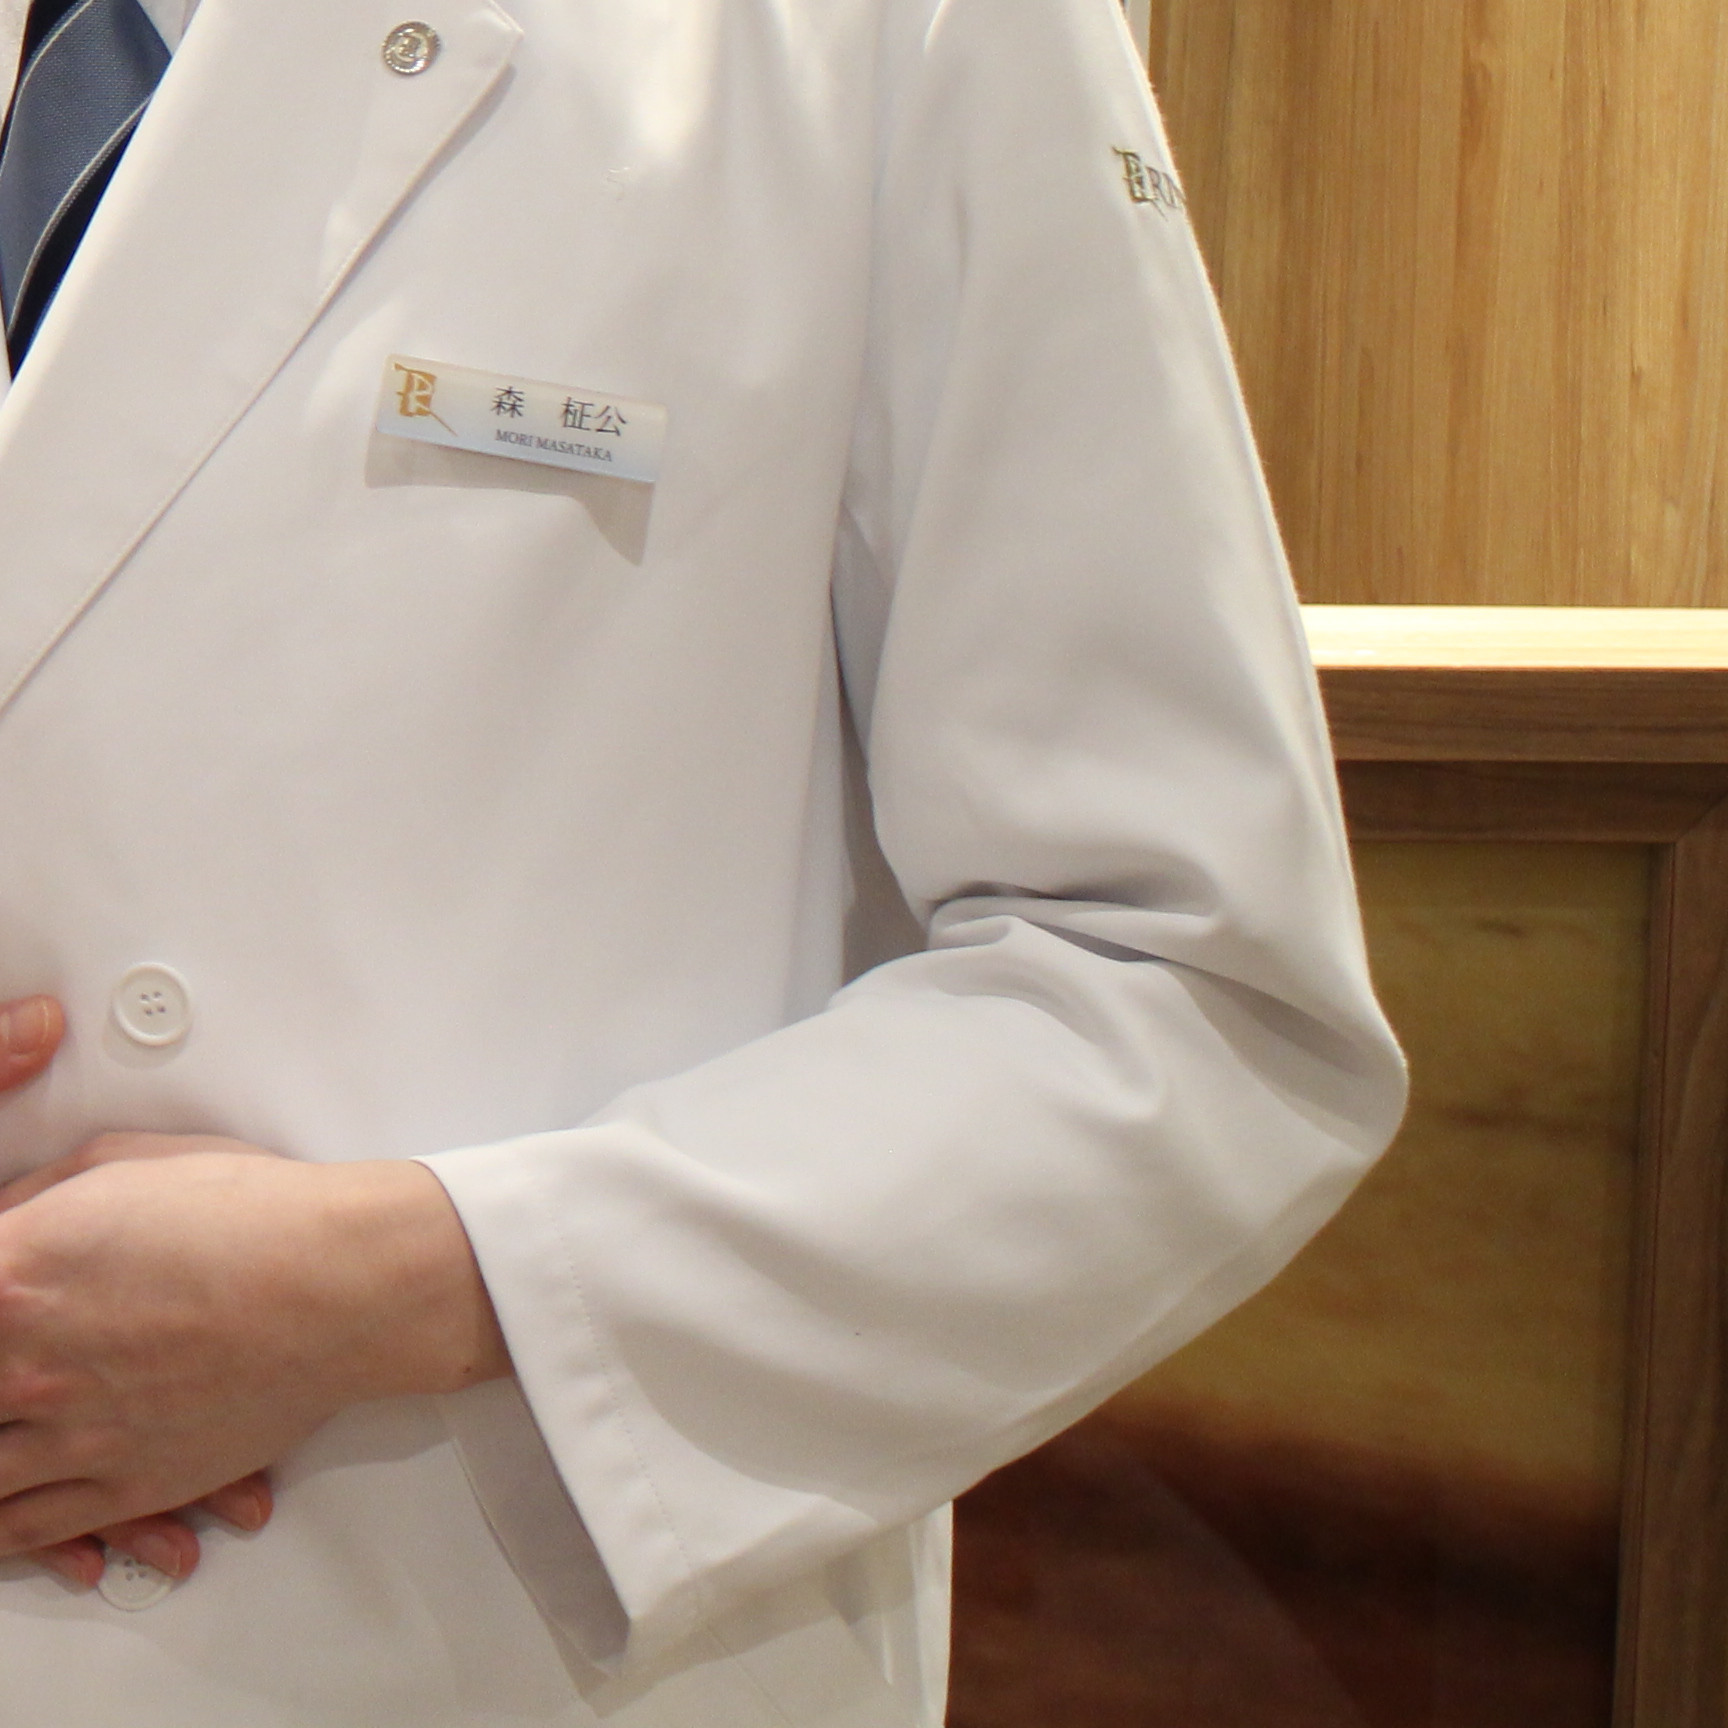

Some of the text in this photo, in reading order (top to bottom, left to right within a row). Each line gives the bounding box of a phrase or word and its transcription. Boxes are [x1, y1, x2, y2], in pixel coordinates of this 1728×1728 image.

[490, 385, 628, 438] 森 柾公
[495, 428, 613, 463] MORI MASATAKA
